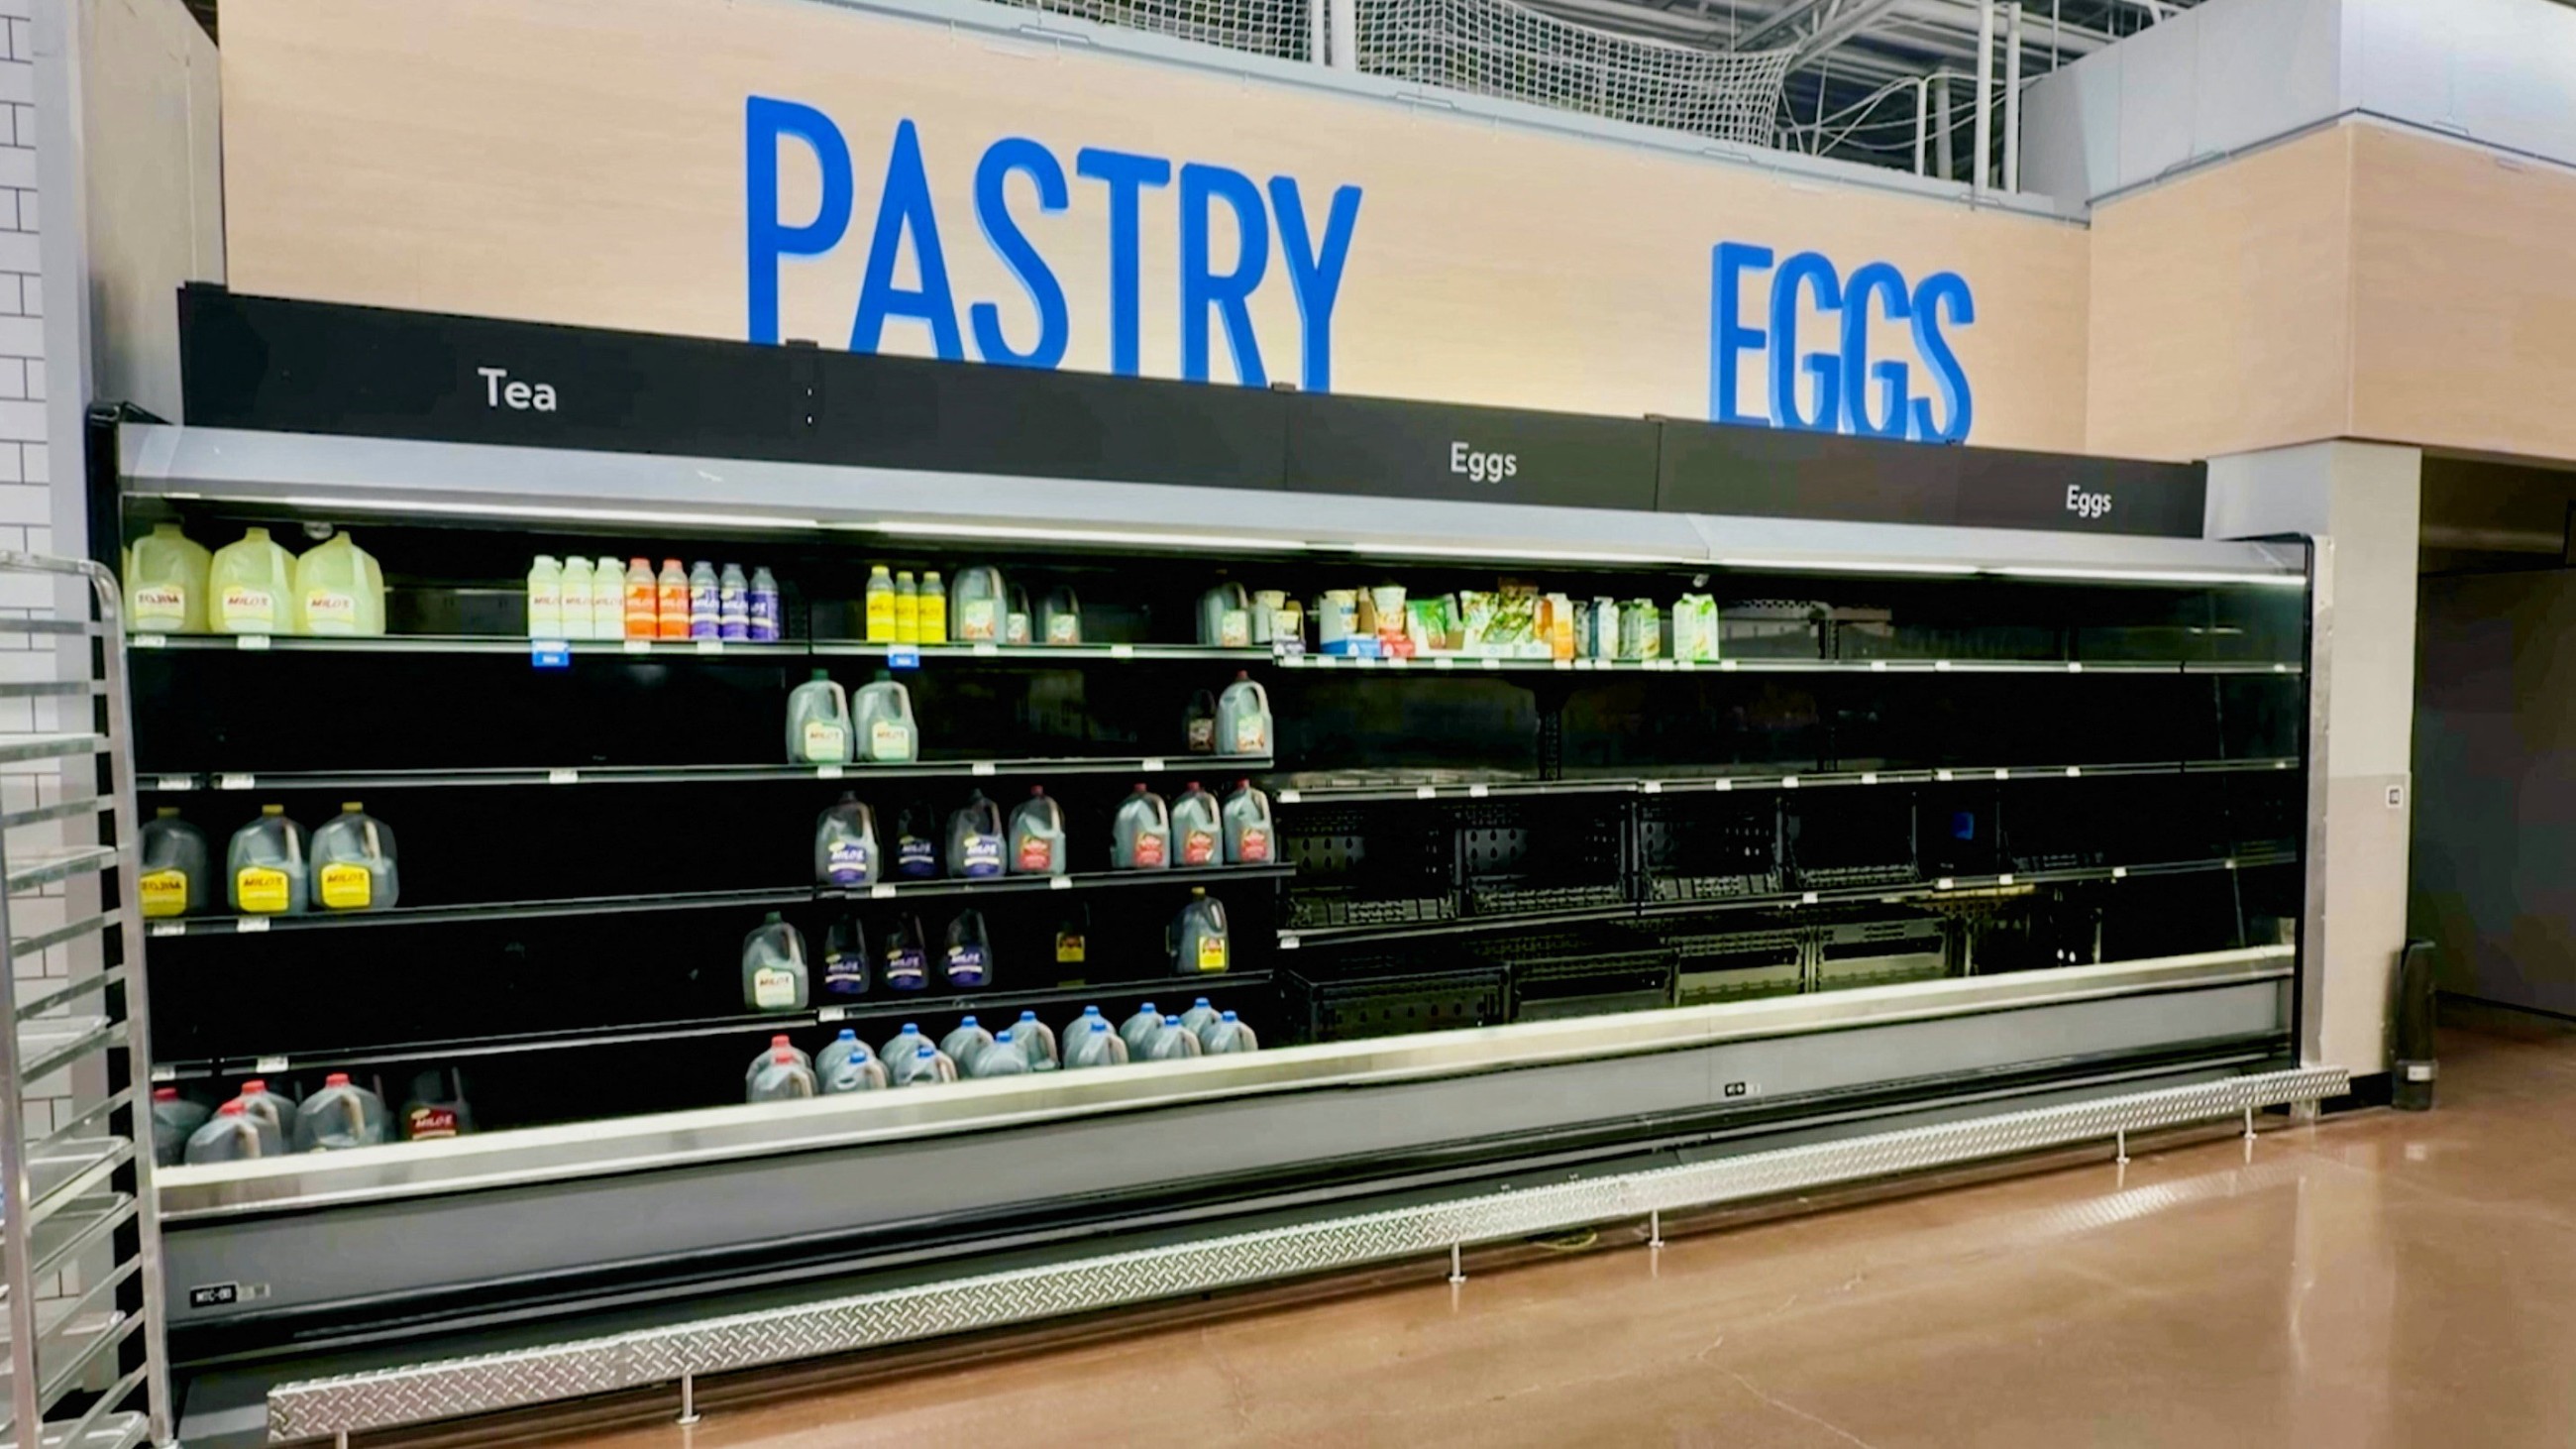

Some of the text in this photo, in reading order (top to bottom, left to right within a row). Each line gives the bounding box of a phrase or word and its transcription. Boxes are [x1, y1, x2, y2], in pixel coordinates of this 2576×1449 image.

[746, 95, 1363, 393] PASTRY
[1709, 241, 1975, 445] EGGS
[478, 366, 558, 411] Tea
[1449, 441, 1518, 483] Eggs
[2066, 484, 2112, 518] Eggs
